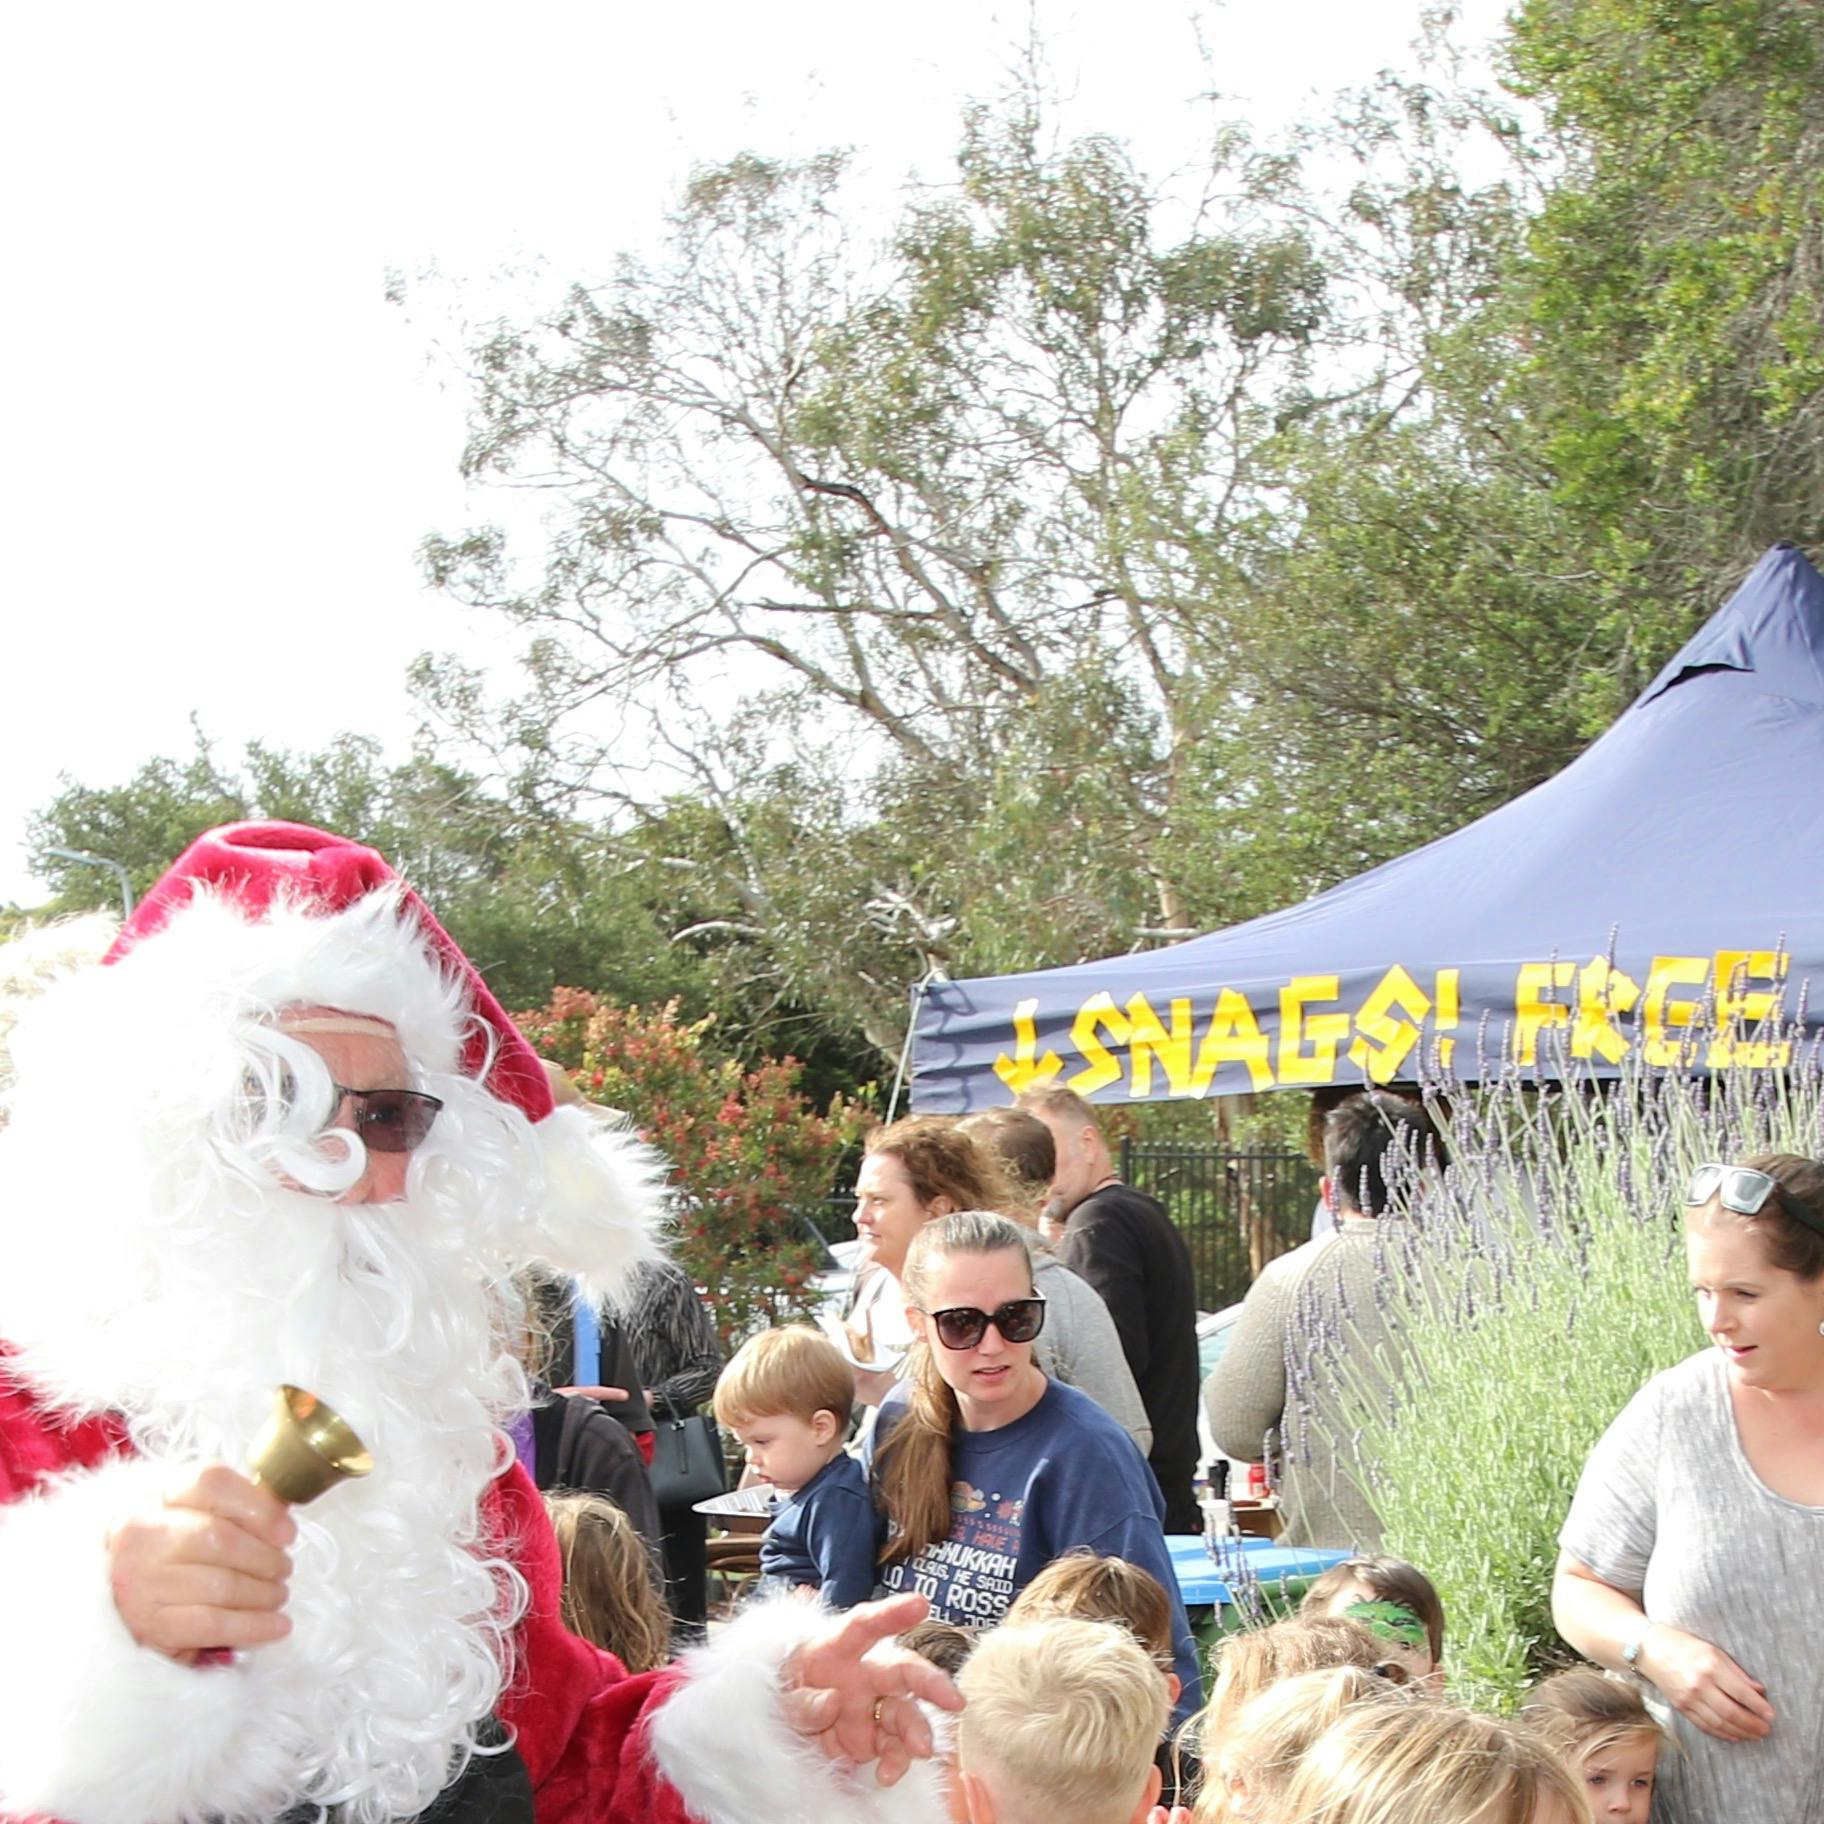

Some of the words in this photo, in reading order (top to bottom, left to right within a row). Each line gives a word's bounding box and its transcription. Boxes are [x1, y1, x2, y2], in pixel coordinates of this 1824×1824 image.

[1516, 951, 1791, 1069] FREE
[912, 1557, 949, 1580] CLAUS,
[953, 1569, 974, 1586] HE
[976, 1576, 1014, 1595] SAID
[914, 1573, 939, 1601] TO
[946, 1584, 1010, 1618] ROSS
[928, 1604, 956, 1626] ELL
[964, 1614, 1000, 1631] JOE
